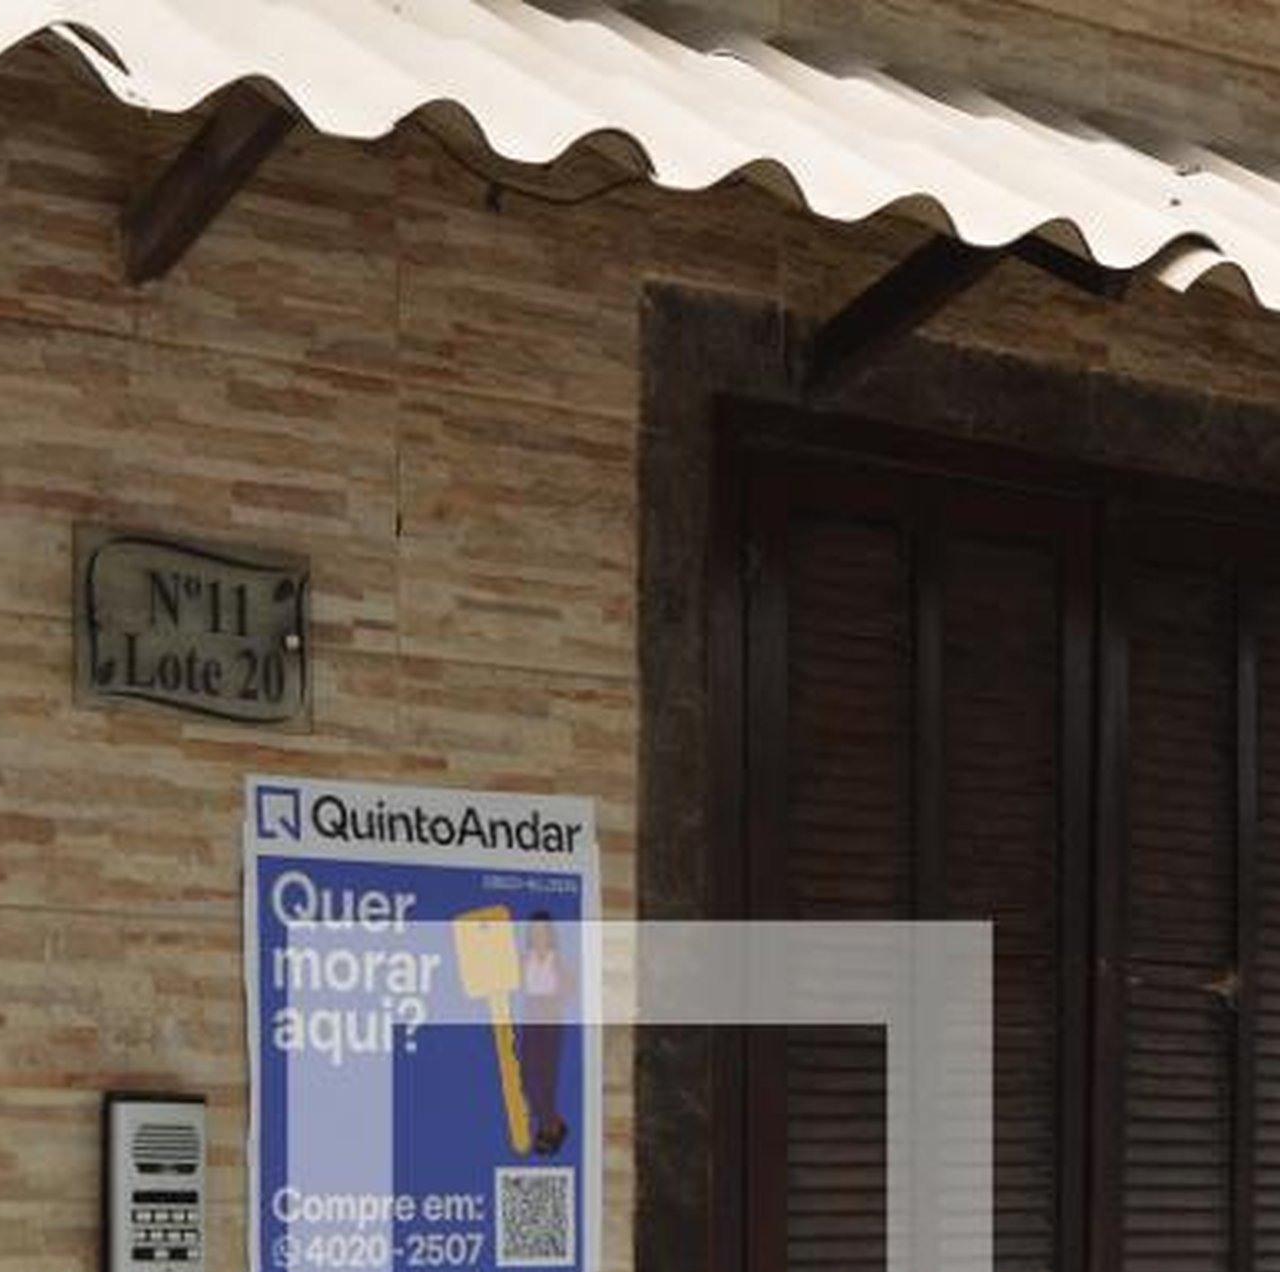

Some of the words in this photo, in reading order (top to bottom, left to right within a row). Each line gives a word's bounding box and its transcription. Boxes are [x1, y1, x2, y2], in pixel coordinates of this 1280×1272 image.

[124, 632, 221, 696] Lote
[238, 649, 285, 704] 20
[311, 794, 583, 854] QuintoAndar
[272, 871, 417, 933] Quer
[273, 947, 442, 993] morar
[273, 996, 426, 1066] aqui?
[272, 1187, 416, 1230] Compre
[423, 1194, 486, 1222] em:
[304, 1232, 485, 1269] 4020-2507
